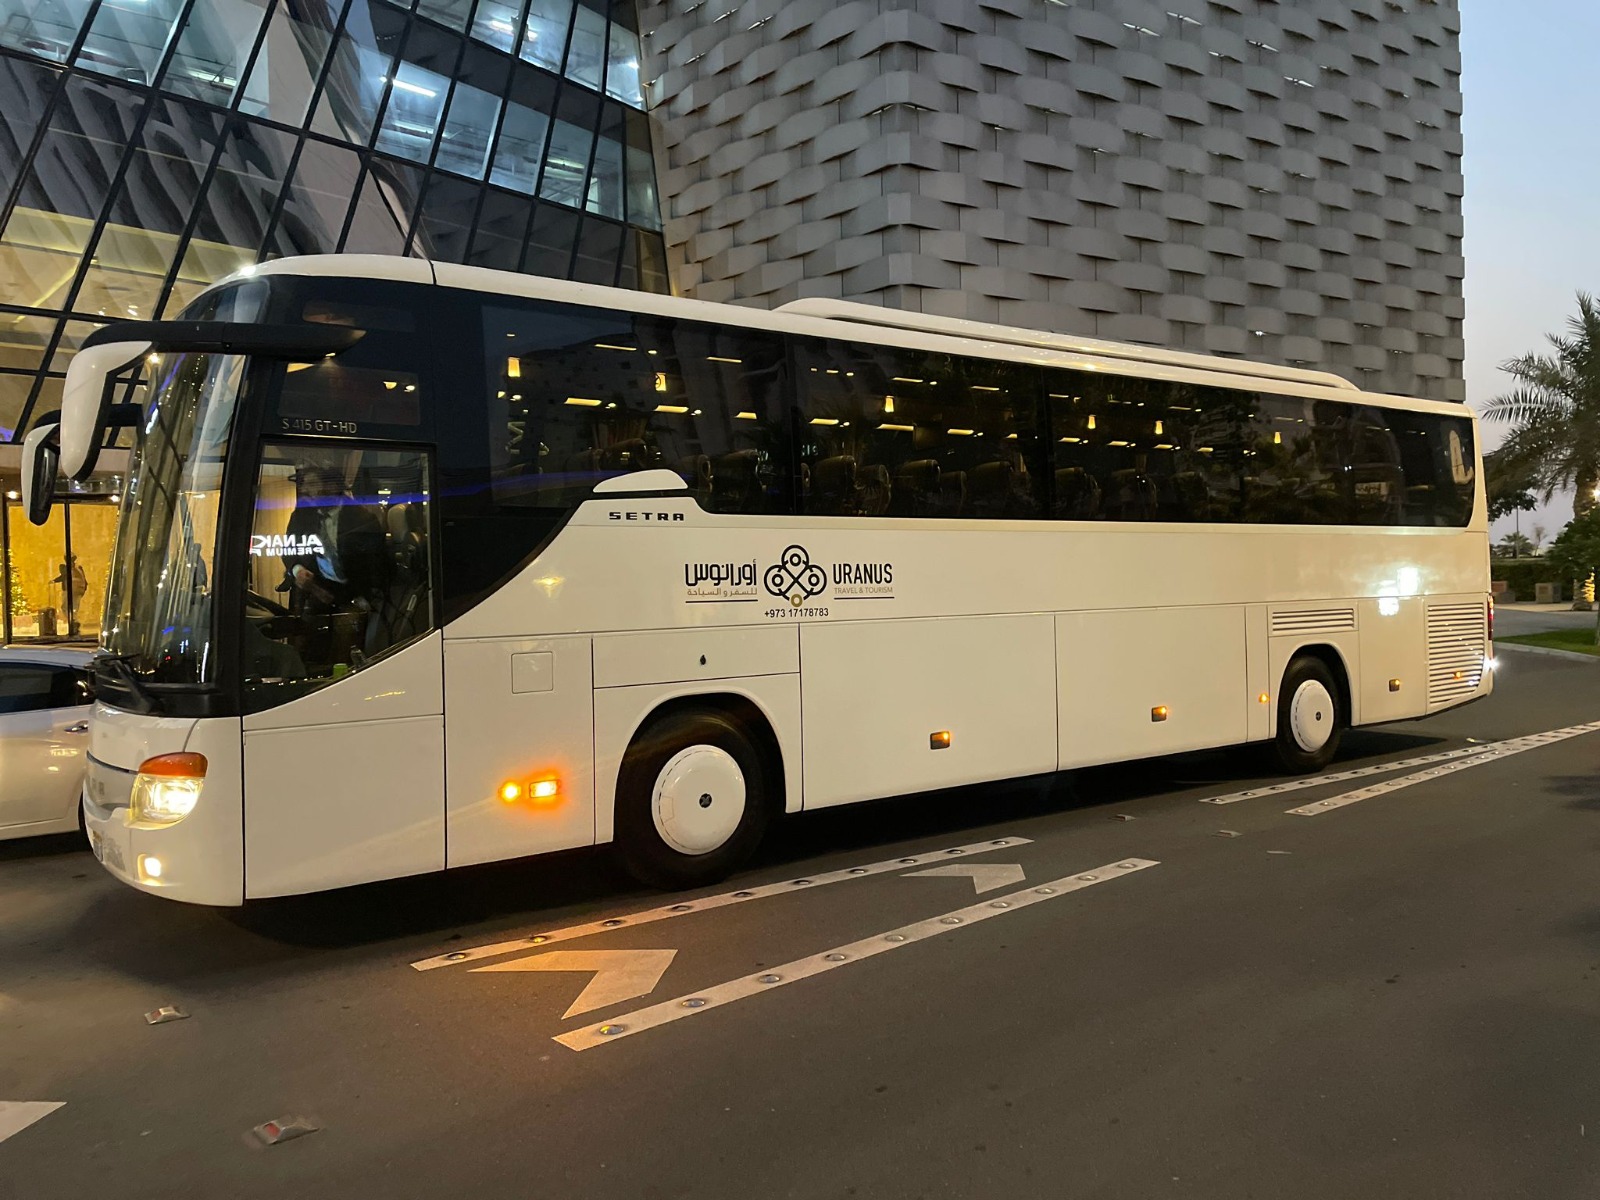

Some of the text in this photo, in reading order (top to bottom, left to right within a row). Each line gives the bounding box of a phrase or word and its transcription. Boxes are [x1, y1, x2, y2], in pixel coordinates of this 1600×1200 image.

[282, 418, 357, 434] S 415 GT-HD
[608, 511, 684, 521] SETRA
[684, 558, 757, 587] أورانوس
[832, 563, 893, 585] URANUS
[687, 587, 721, 598] السياحة
[833, 587, 858, 595] TRAVEL
[865, 586, 893, 594] TOURISM
[764, 607, 829, 618] +973 17178783
